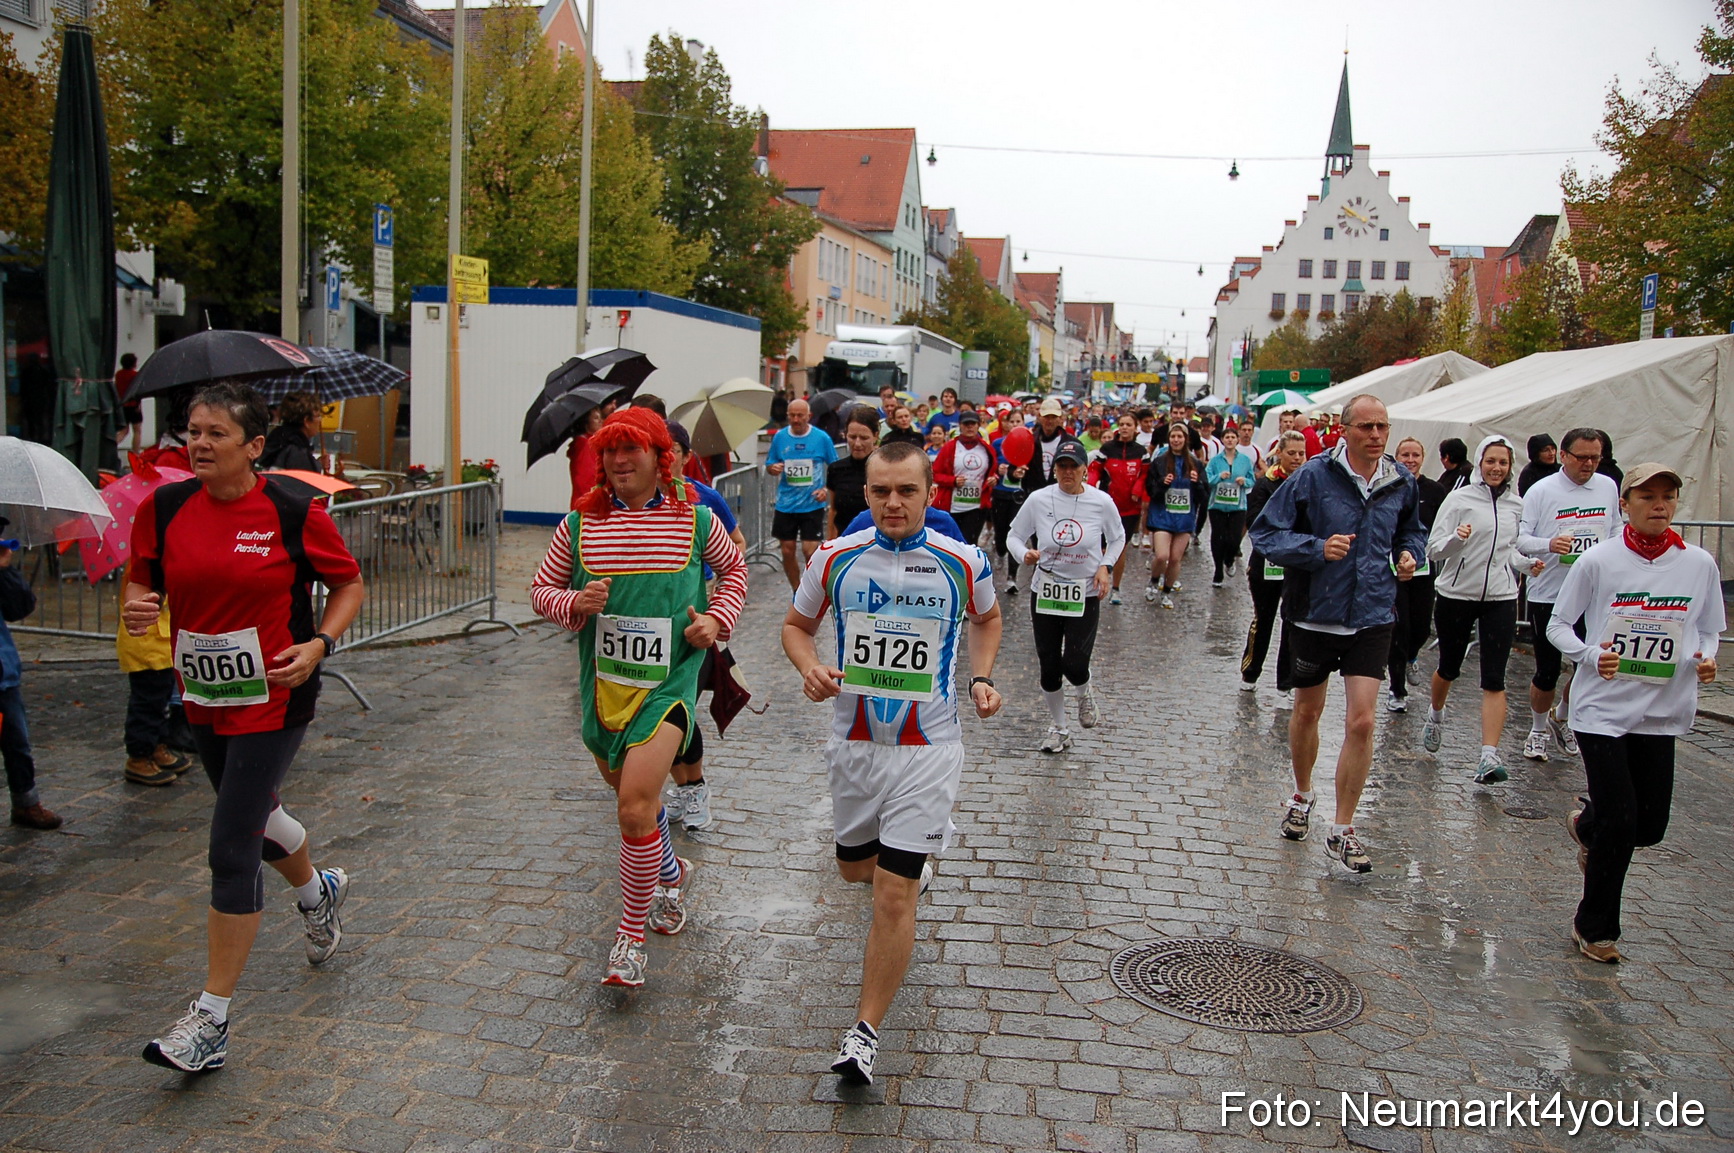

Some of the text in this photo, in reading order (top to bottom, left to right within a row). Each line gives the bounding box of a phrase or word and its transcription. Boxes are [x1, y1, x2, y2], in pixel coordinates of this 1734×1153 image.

[328, 271, 339, 304] P
[1644, 279, 1655, 306] P
[787, 466, 810, 477] 5217
[956, 487, 980, 497] 5038
[1217, 487, 1238, 497] 5214
[1167, 494, 1188, 505] 5225
[236, 530, 275, 541] Lauftreff
[234, 543, 271, 557] Parsberg
[921, 566, 937, 574] RACER
[1043, 582, 1081, 601] 5016
[896, 595, 946, 608] PLAST
[616, 620, 648, 630] BOCK
[874, 620, 912, 631] BOCK
[1631, 623, 1662, 631] BOCK
[194, 638, 229, 648] BOCK
[602, 631, 663, 663] 5104
[1611, 633, 1674, 661] 5179
[853, 634, 929, 670] 5126
[181, 651, 256, 682] 5060
[613, 663, 648, 678] Werner
[1630, 663, 1647, 674] Ola
[870, 672, 905, 688] Viktor
